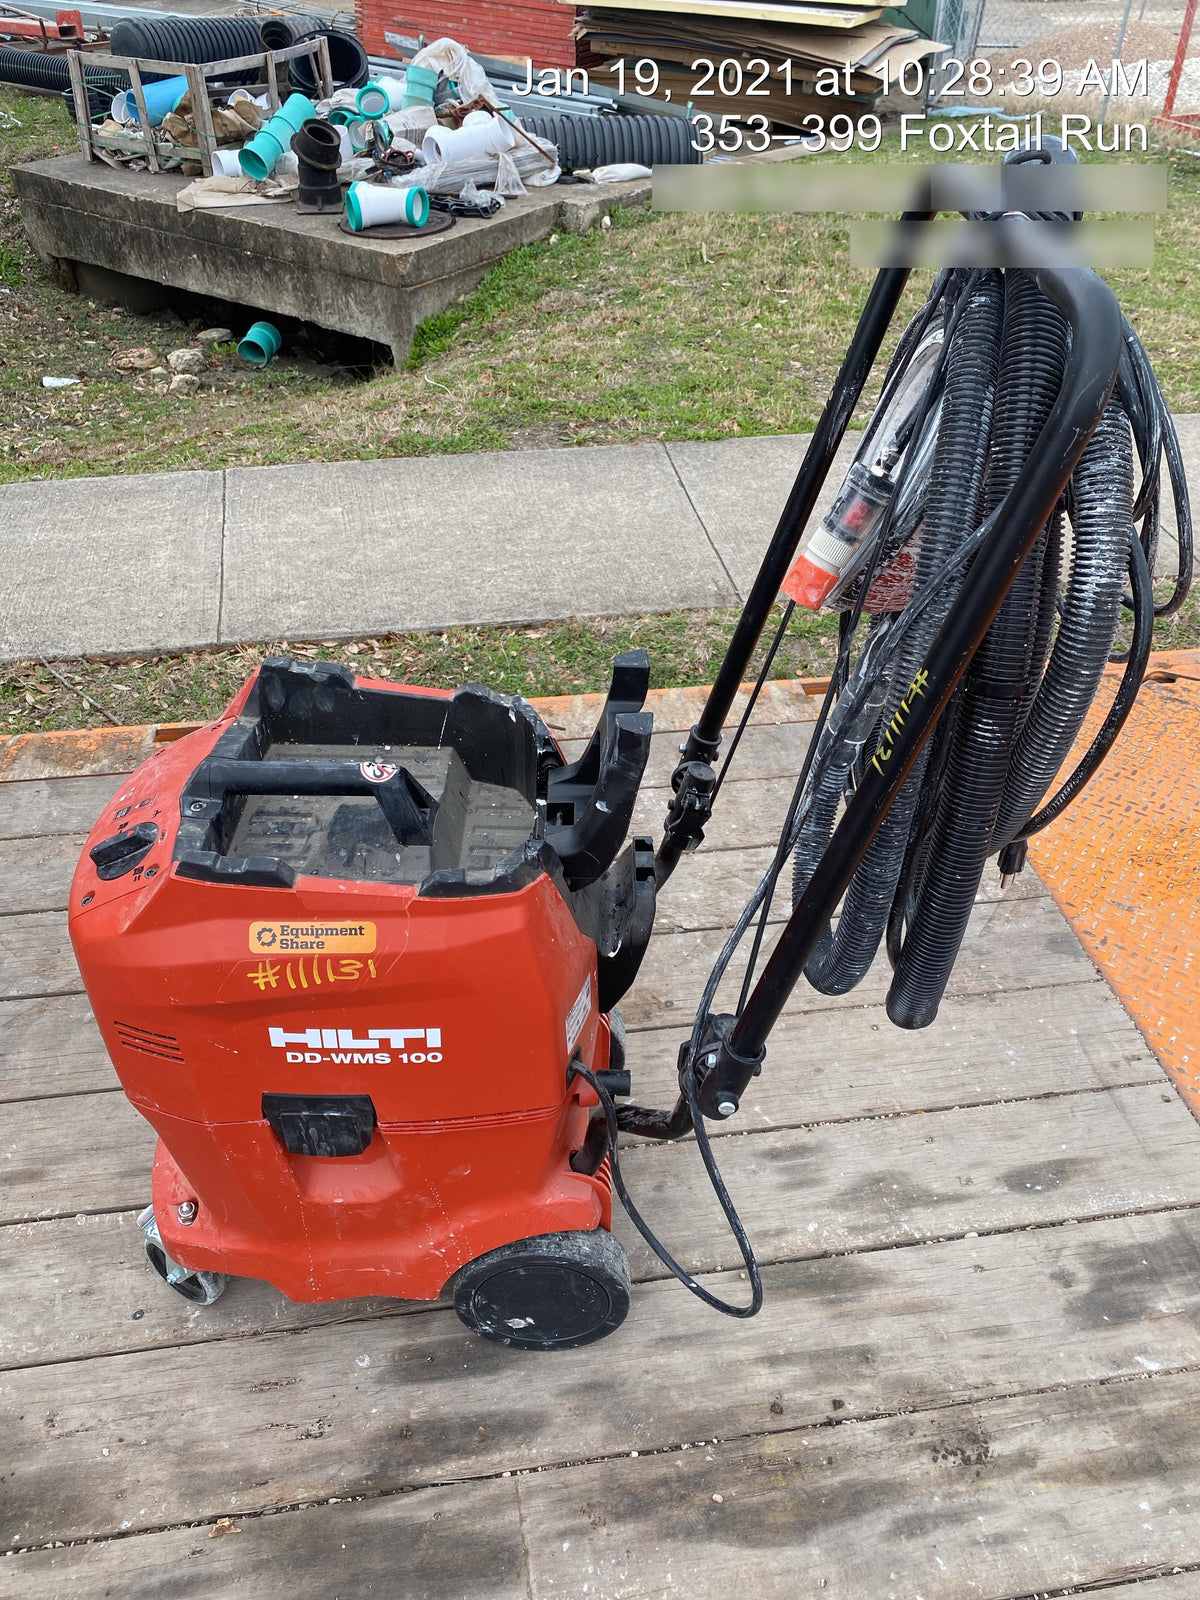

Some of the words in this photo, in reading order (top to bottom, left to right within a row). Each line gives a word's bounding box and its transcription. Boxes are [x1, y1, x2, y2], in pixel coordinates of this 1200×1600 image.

[279, 925, 365, 939] Equipment
[279, 938, 325, 950] Share
[268, 1027, 442, 1049] HILTI
[286, 1051, 391, 1064] DD-WMS
[398, 1052, 443, 1063] 100
